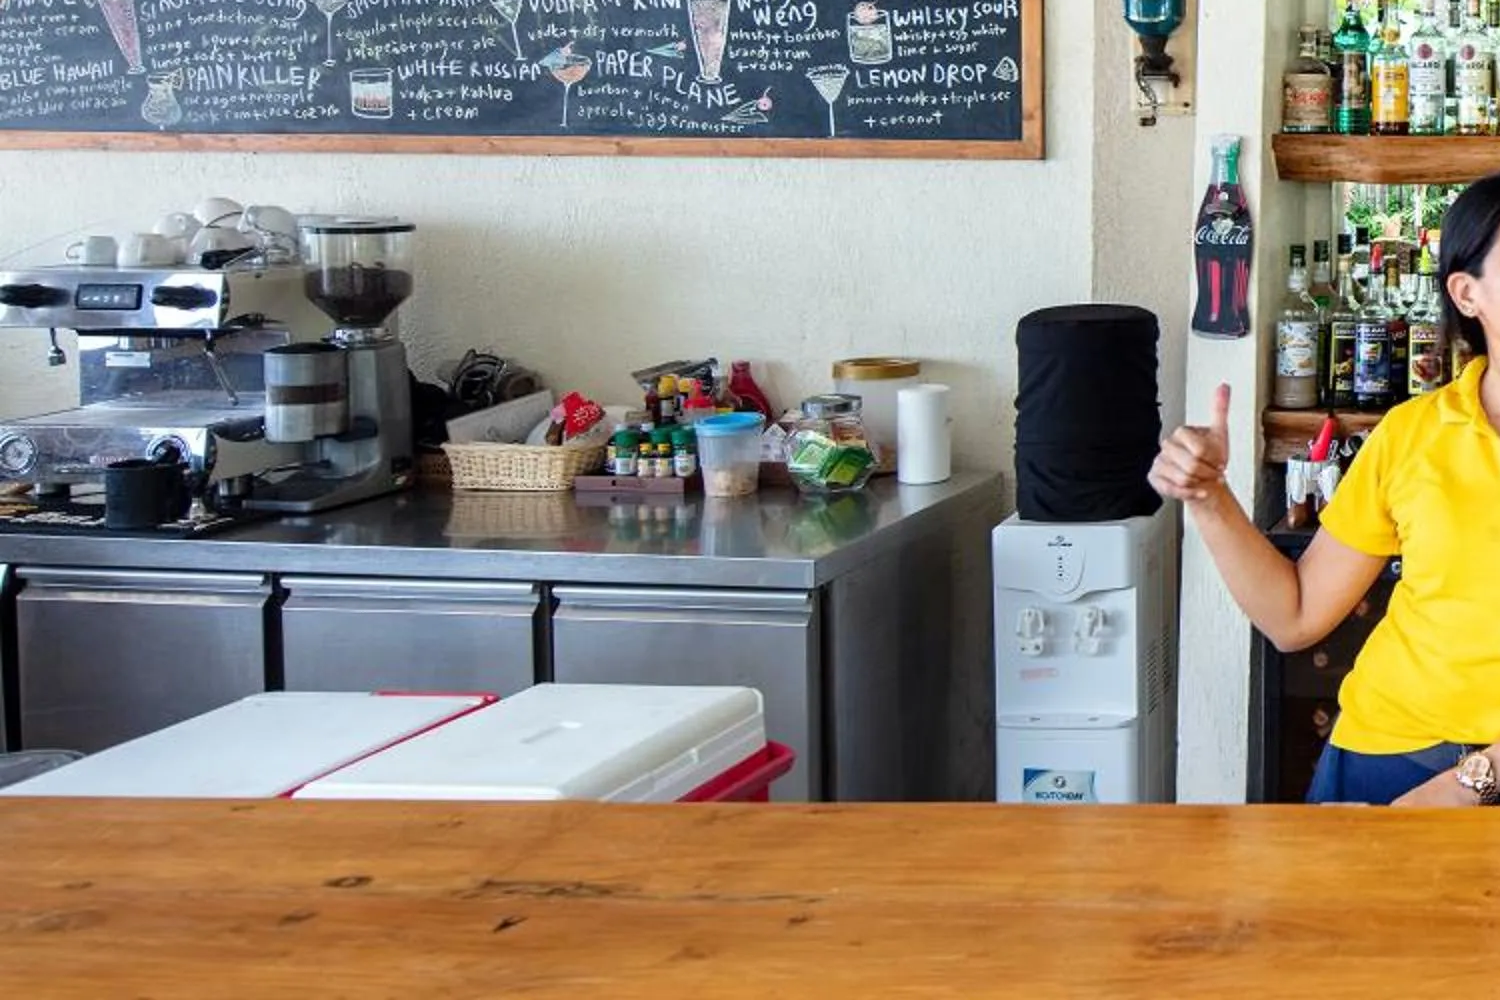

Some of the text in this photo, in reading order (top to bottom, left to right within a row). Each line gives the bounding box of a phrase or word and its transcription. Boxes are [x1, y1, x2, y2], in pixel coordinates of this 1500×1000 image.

[597, 50, 653, 77] PAPER
[855, 63, 987, 88] LEMON DROP
